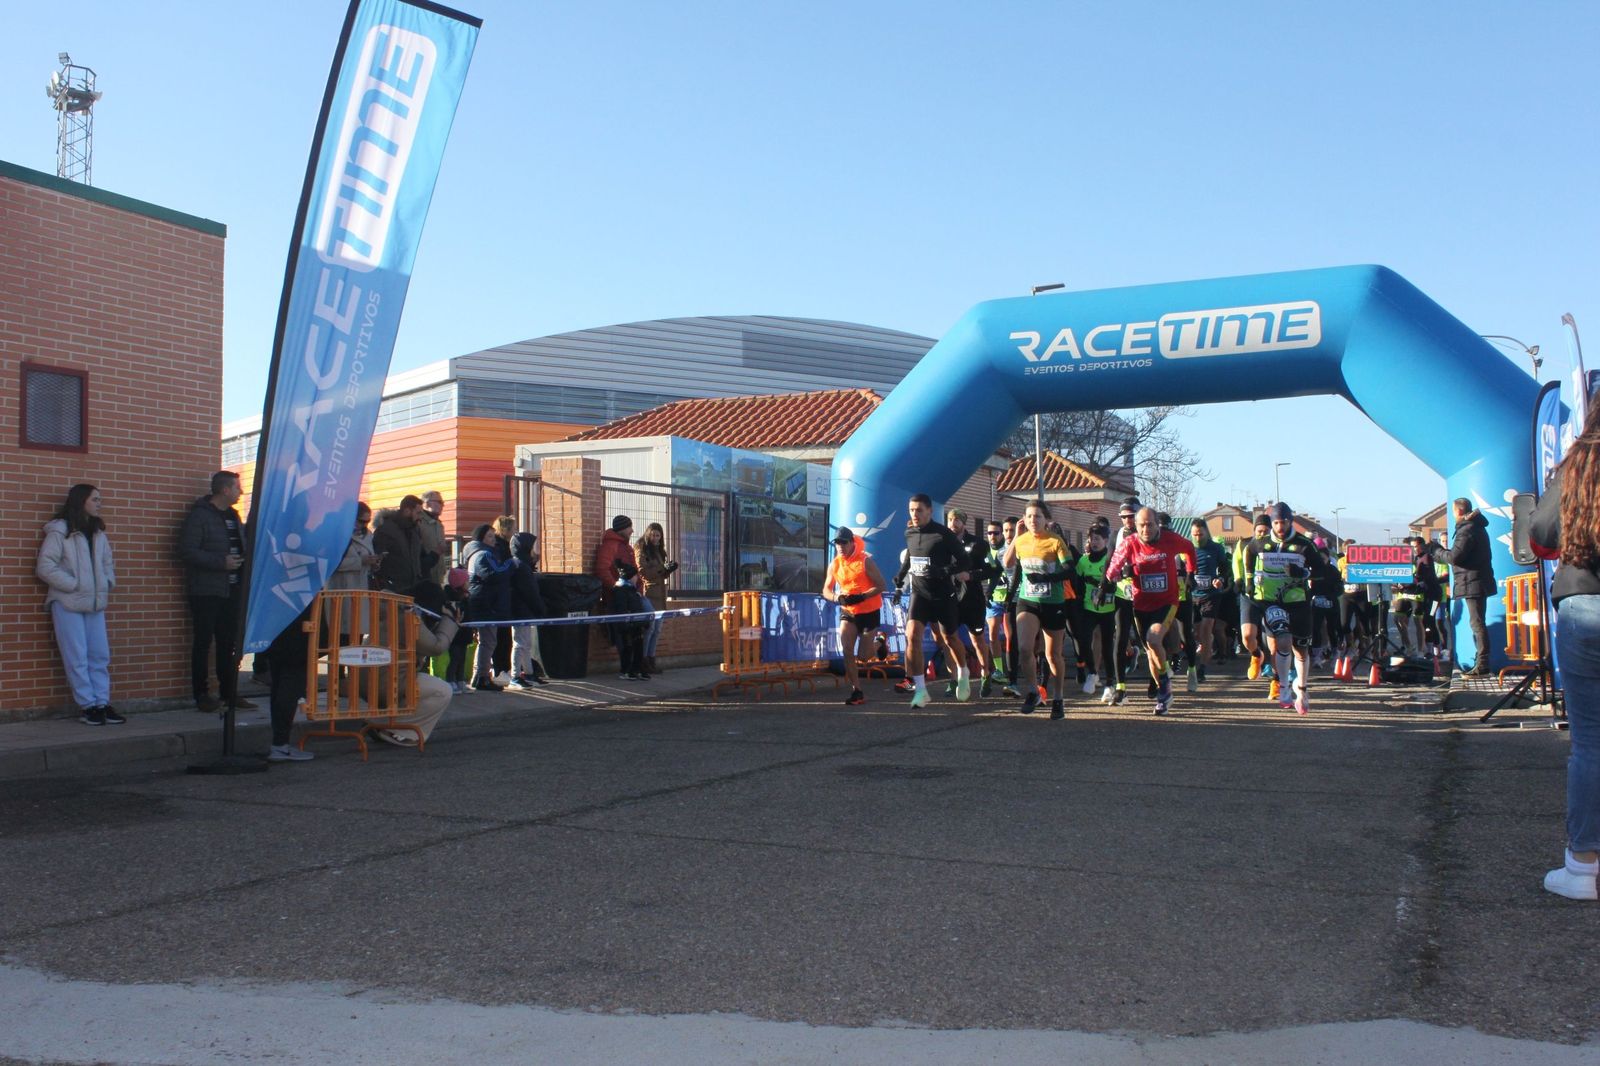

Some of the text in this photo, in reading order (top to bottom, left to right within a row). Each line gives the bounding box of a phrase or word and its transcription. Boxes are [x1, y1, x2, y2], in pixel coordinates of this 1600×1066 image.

[323, 289, 381, 501] EVENTOS DEPORTIVOS
[1024, 358, 1153, 375] EVENTOS DEPORTIVOS
